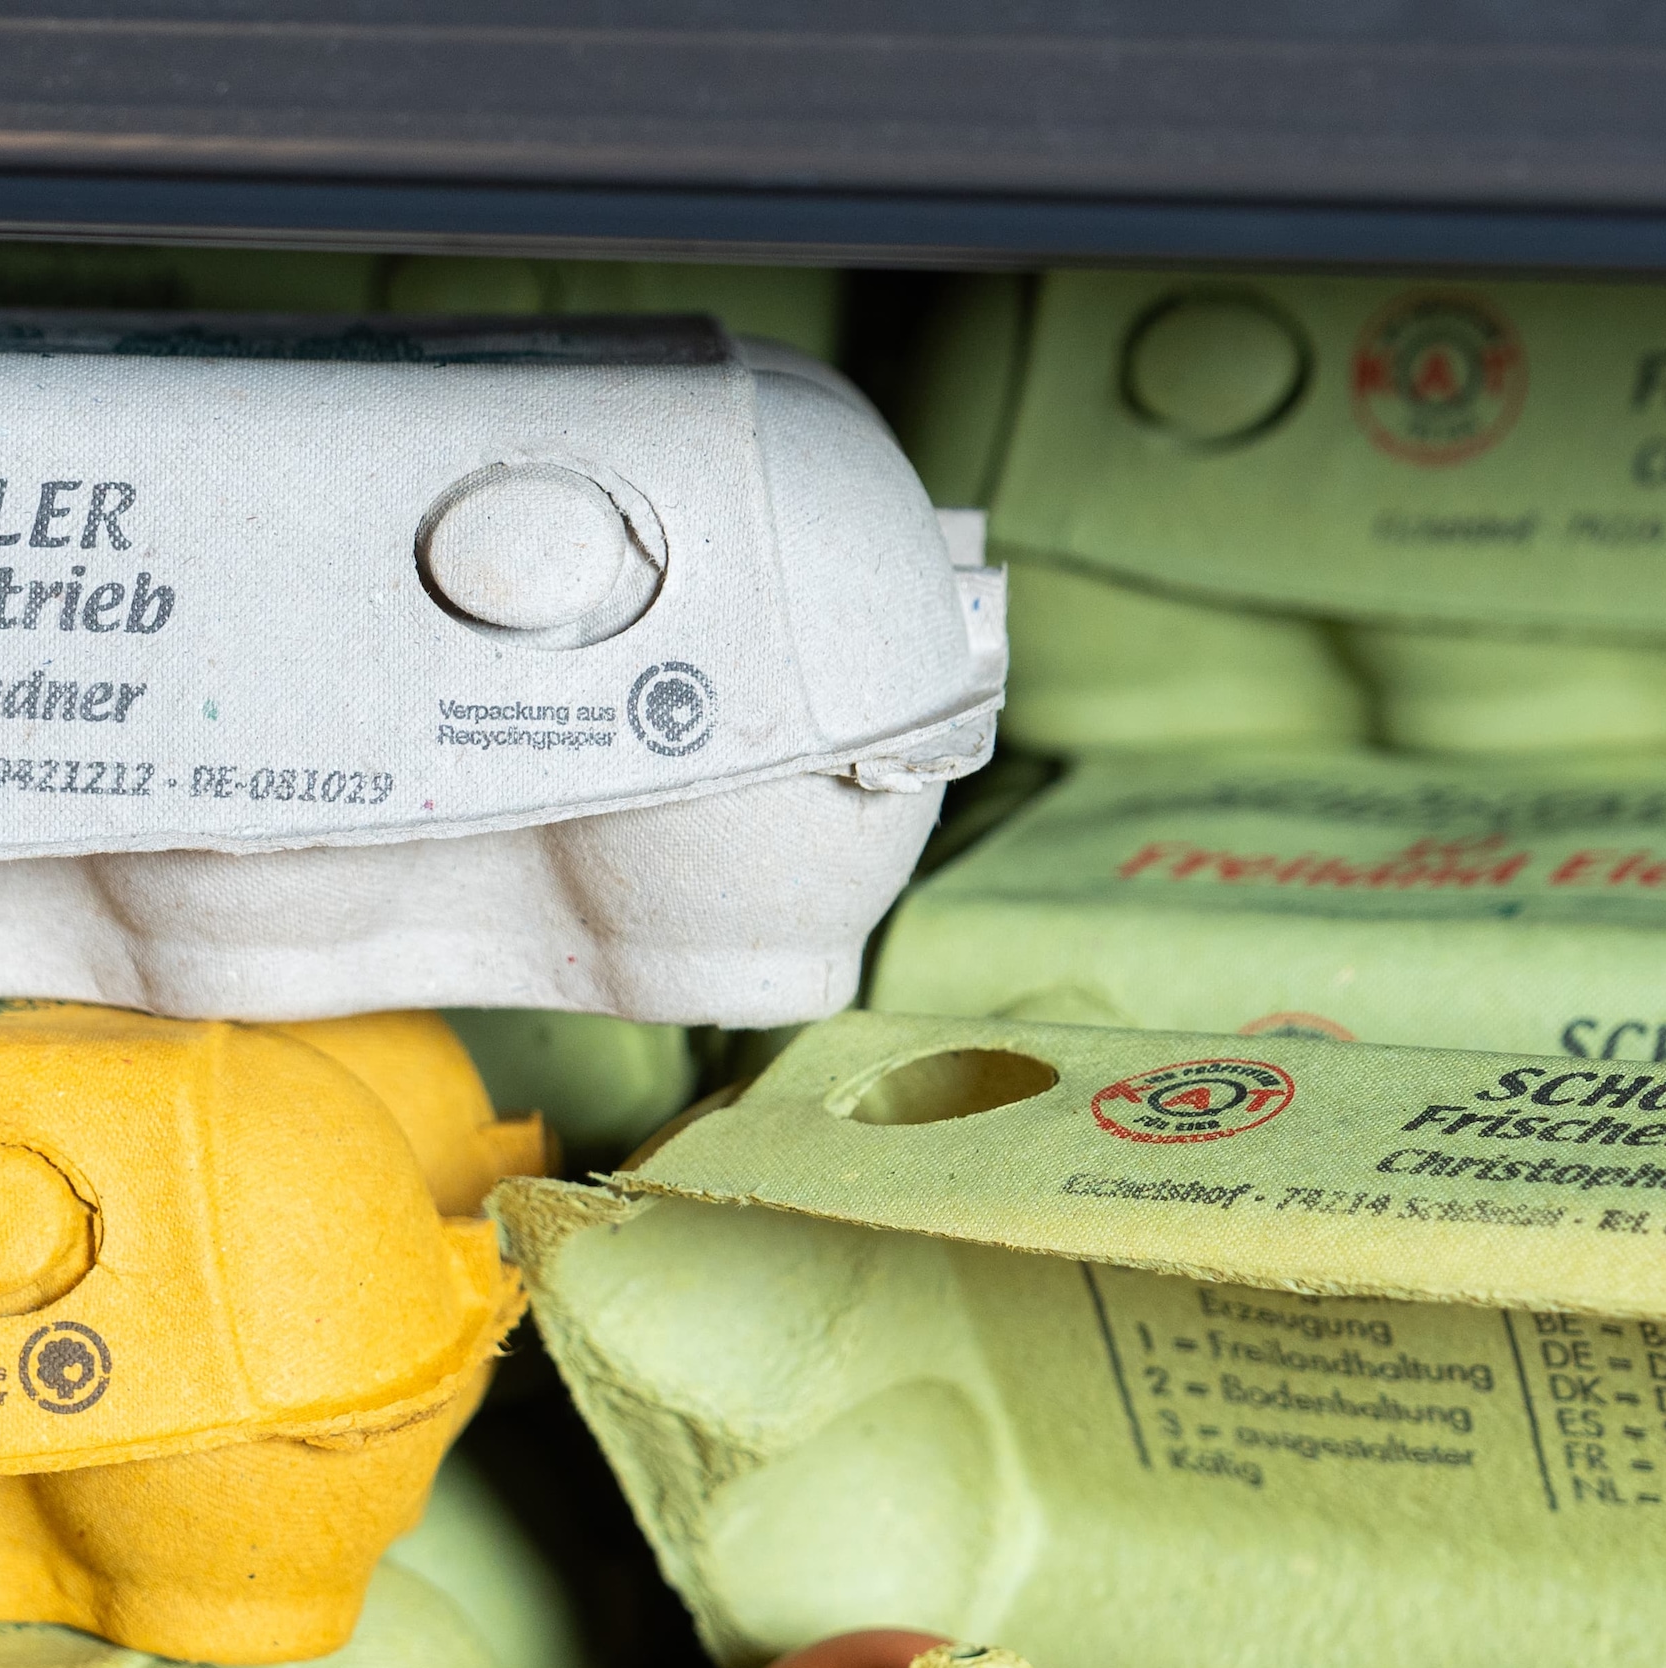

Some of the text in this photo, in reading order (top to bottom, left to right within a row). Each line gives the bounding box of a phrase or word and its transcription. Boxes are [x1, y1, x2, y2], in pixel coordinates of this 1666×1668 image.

[438, 700, 616, 725] Verpackung aus
[436, 725, 617, 750] Recyclingpapier
[189, 765, 396, 805] DE-081029
[1541, 1339, 1596, 1369] DE
[1221, 1372, 1472, 1433] Bodenhaltung
[1549, 1373, 1606, 1406] DK
[1556, 1407, 1605, 1439] ES
[1562, 1442, 1609, 1472] FR
